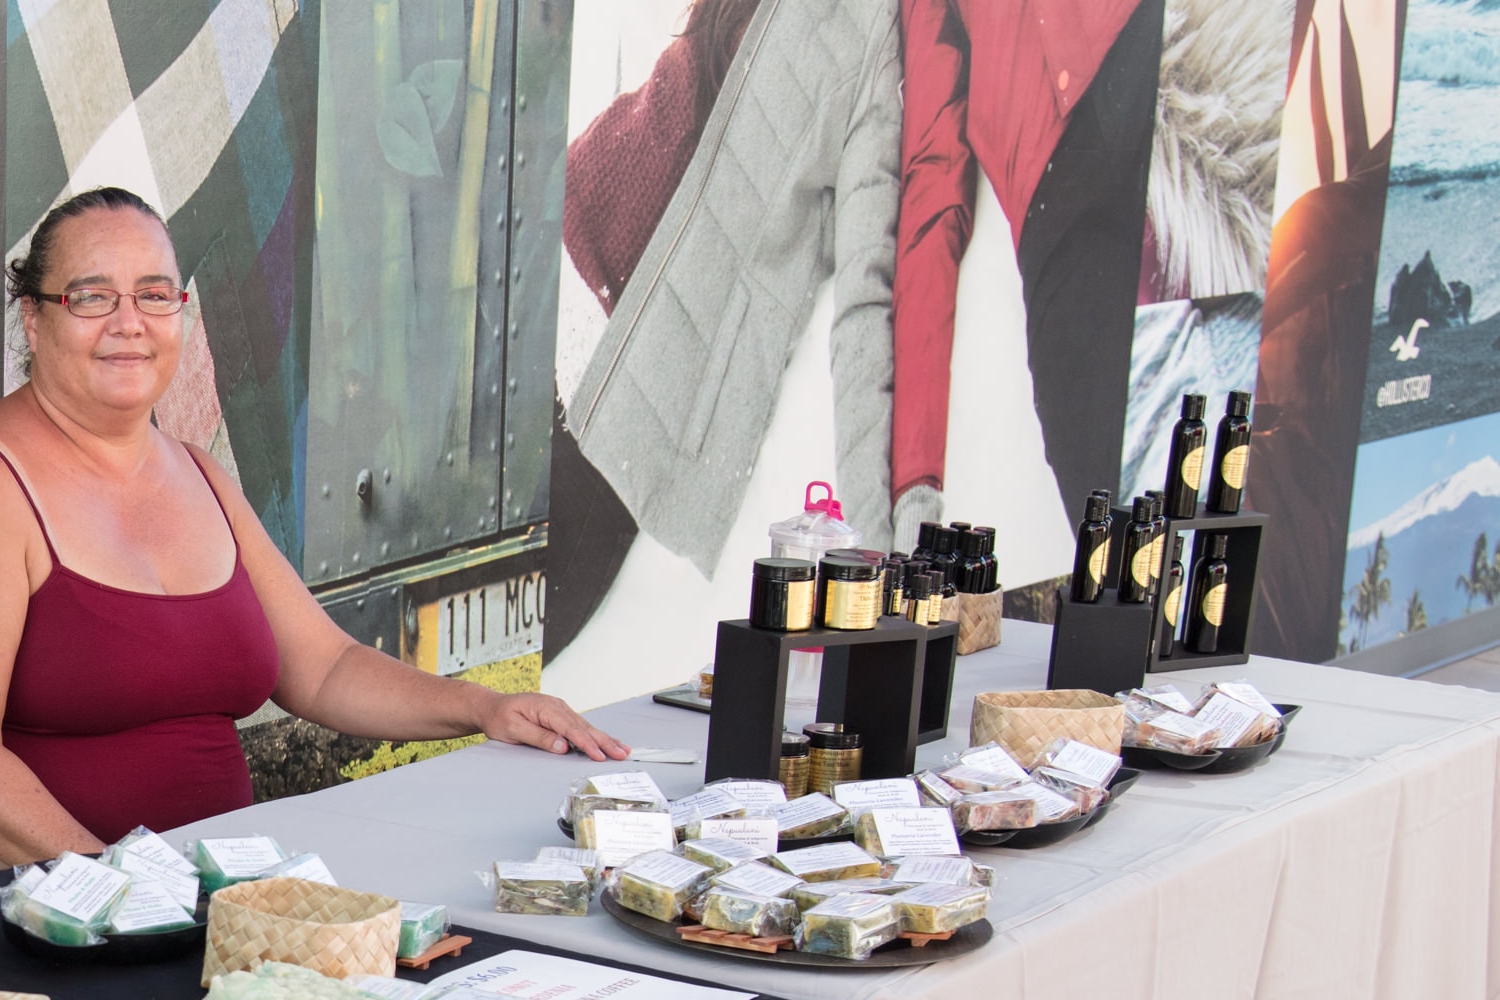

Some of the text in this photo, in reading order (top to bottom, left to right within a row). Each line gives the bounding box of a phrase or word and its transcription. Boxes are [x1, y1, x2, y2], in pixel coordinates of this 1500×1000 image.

[447, 588, 486, 656] 111
[496, 979, 539, 996] CONUT
[596, 977, 641, 998] COFFEE
